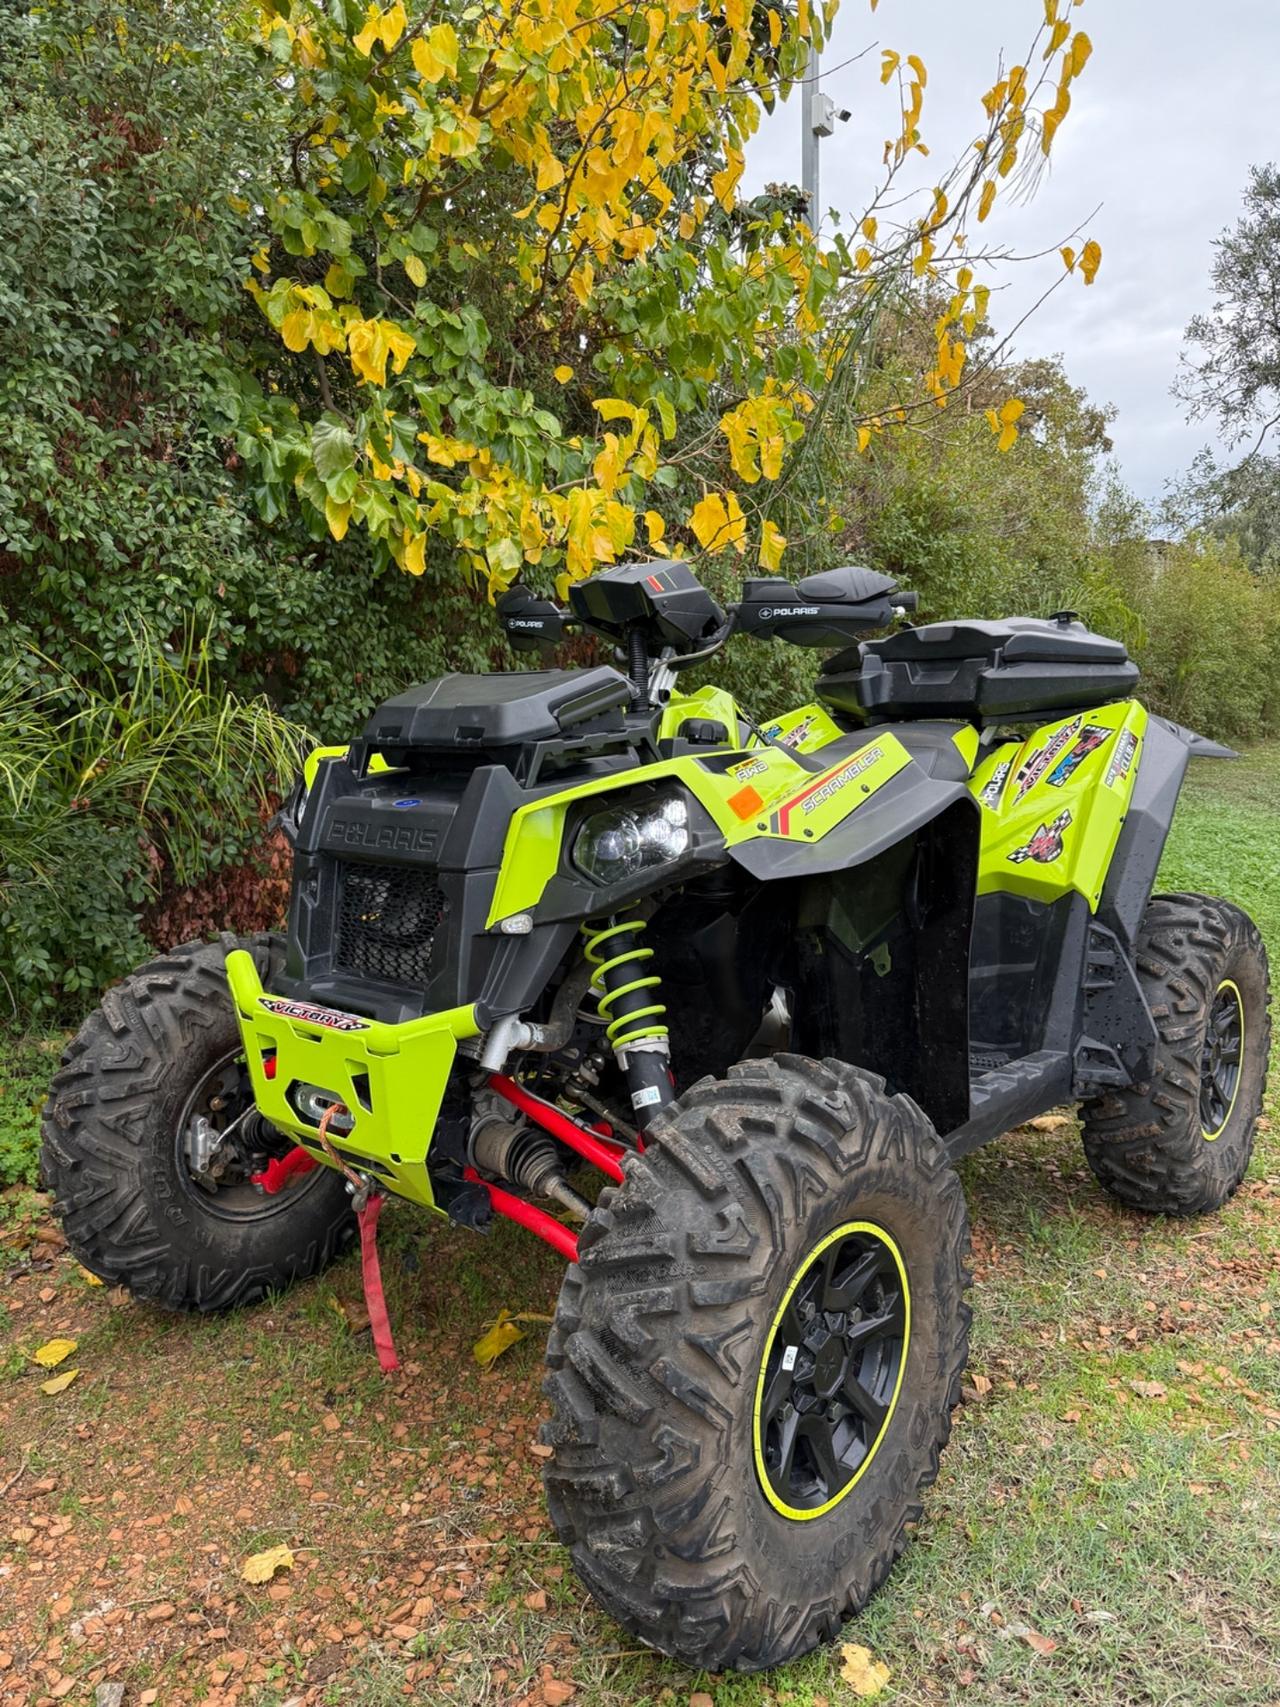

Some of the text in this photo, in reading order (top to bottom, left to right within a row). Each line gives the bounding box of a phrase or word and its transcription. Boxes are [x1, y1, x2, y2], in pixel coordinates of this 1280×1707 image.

[515, 620, 544, 629] POLARIS
[774, 606, 820, 617] POLARIS
[736, 760, 769, 783] AWD
[801, 746, 884, 816] SCRAMBLER
[983, 761, 1010, 801] POLARIS
[327, 819, 440, 853] POLARIS
[274, 1000, 344, 1028] VICTORY
